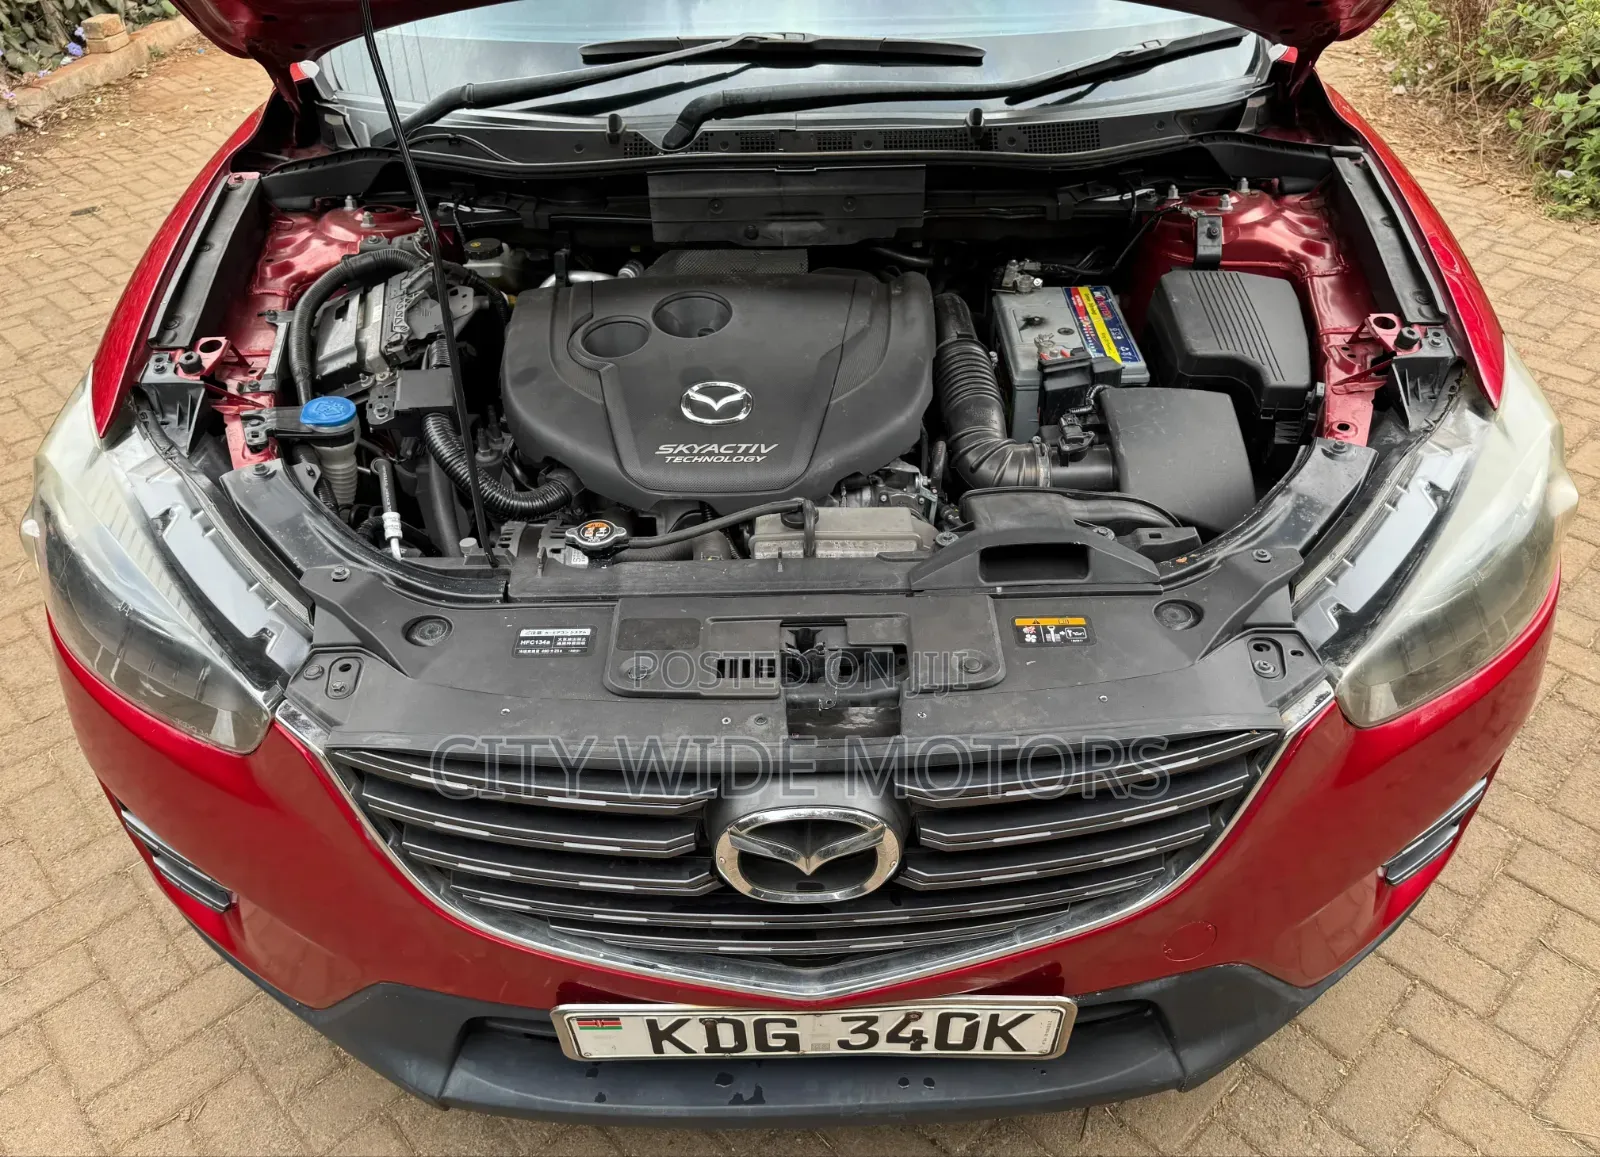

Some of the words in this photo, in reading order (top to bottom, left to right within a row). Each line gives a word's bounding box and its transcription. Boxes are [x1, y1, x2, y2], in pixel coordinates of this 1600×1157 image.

[655, 443, 779, 455] SKYACTIV
[665, 455, 767, 463] TECHNOLOGY
[647, 1016, 801, 1055] KDG
[836, 1010, 1036, 1052] 340K
